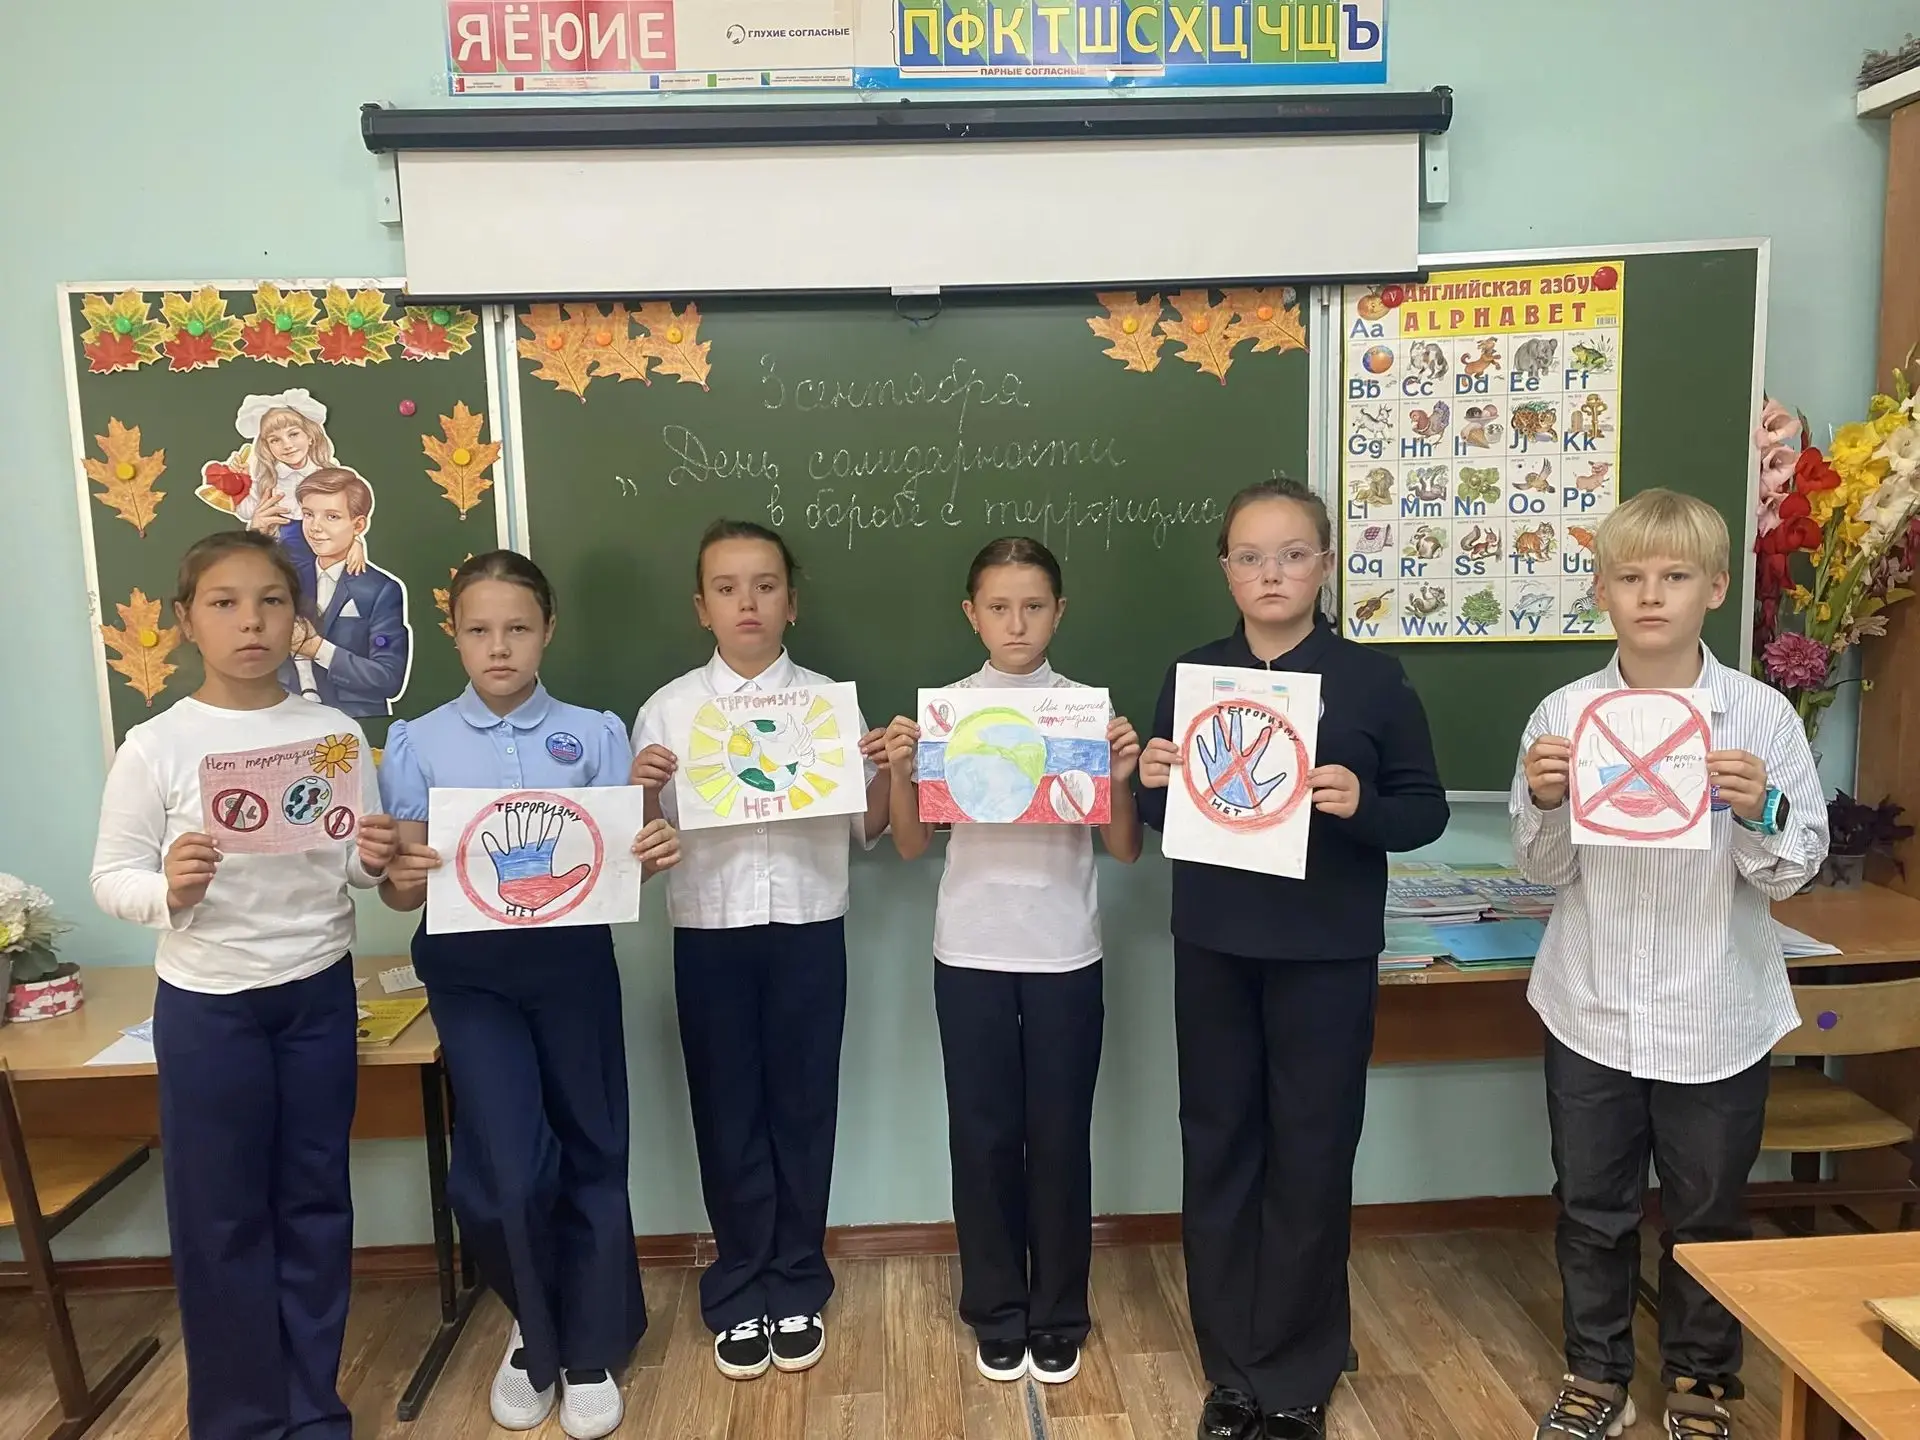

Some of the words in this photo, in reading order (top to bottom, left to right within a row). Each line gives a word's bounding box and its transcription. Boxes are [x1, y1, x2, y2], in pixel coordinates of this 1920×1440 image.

[748, 29, 787, 38] ГЛУХИЕ
[789, 28, 850, 37] СОГЛАСНЫЕ
[980, 67, 1021, 76] ПАРНЫЕ
[1024, 67, 1086, 76] СОГЛАСНЫЕ
[1403, 279, 1532, 301] Английская
[1540, 273, 1617, 296] азбу
[1350, 318, 1384, 339] Aa
[1404, 302, 1586, 332] ALPHABET
[1349, 378, 1381, 399] Bb
[1402, 376, 1433, 397] Cc
[1455, 373, 1489, 395] Dd
[1510, 371, 1540, 392] Ee
[1565, 369, 1589, 390] Ff
[1349, 433, 1383, 458] Gg
[1401, 437, 1433, 458] Hh
[1563, 431, 1597, 451] Kk
[1400, 497, 1441, 518] Mm
[1454, 495, 1486, 516] Nn
[1508, 493, 1545, 514] Oo
[1563, 487, 1596, 512] Pp
[767, 484, 785, 526] в
[941, 502, 962, 526] с
[985, 492, 1226, 561] терроризмо
[1349, 553, 1383, 578] Qq
[1400, 557, 1428, 577] Rr
[1455, 555, 1486, 576] Ss
[1509, 553, 1535, 576] Tt
[1562, 552, 1595, 574] Uu
[1348, 617, 1379, 637] Vv
[1400, 616, 1448, 637] Ww
[1455, 615, 1489, 636] Xx
[1508, 609, 1542, 634] Yy
[1562, 614, 1595, 634] Zz
[1216, 705, 1300, 741] ТЕРРОРИЗМУ
[205, 755, 236, 770] Нет
[495, 802, 582, 822] ТЕРРОРИЗМУ
[743, 795, 787, 819] НЕТ
[1211, 798, 1242, 816] НЕТ
[506, 904, 538, 918] НЕТ
